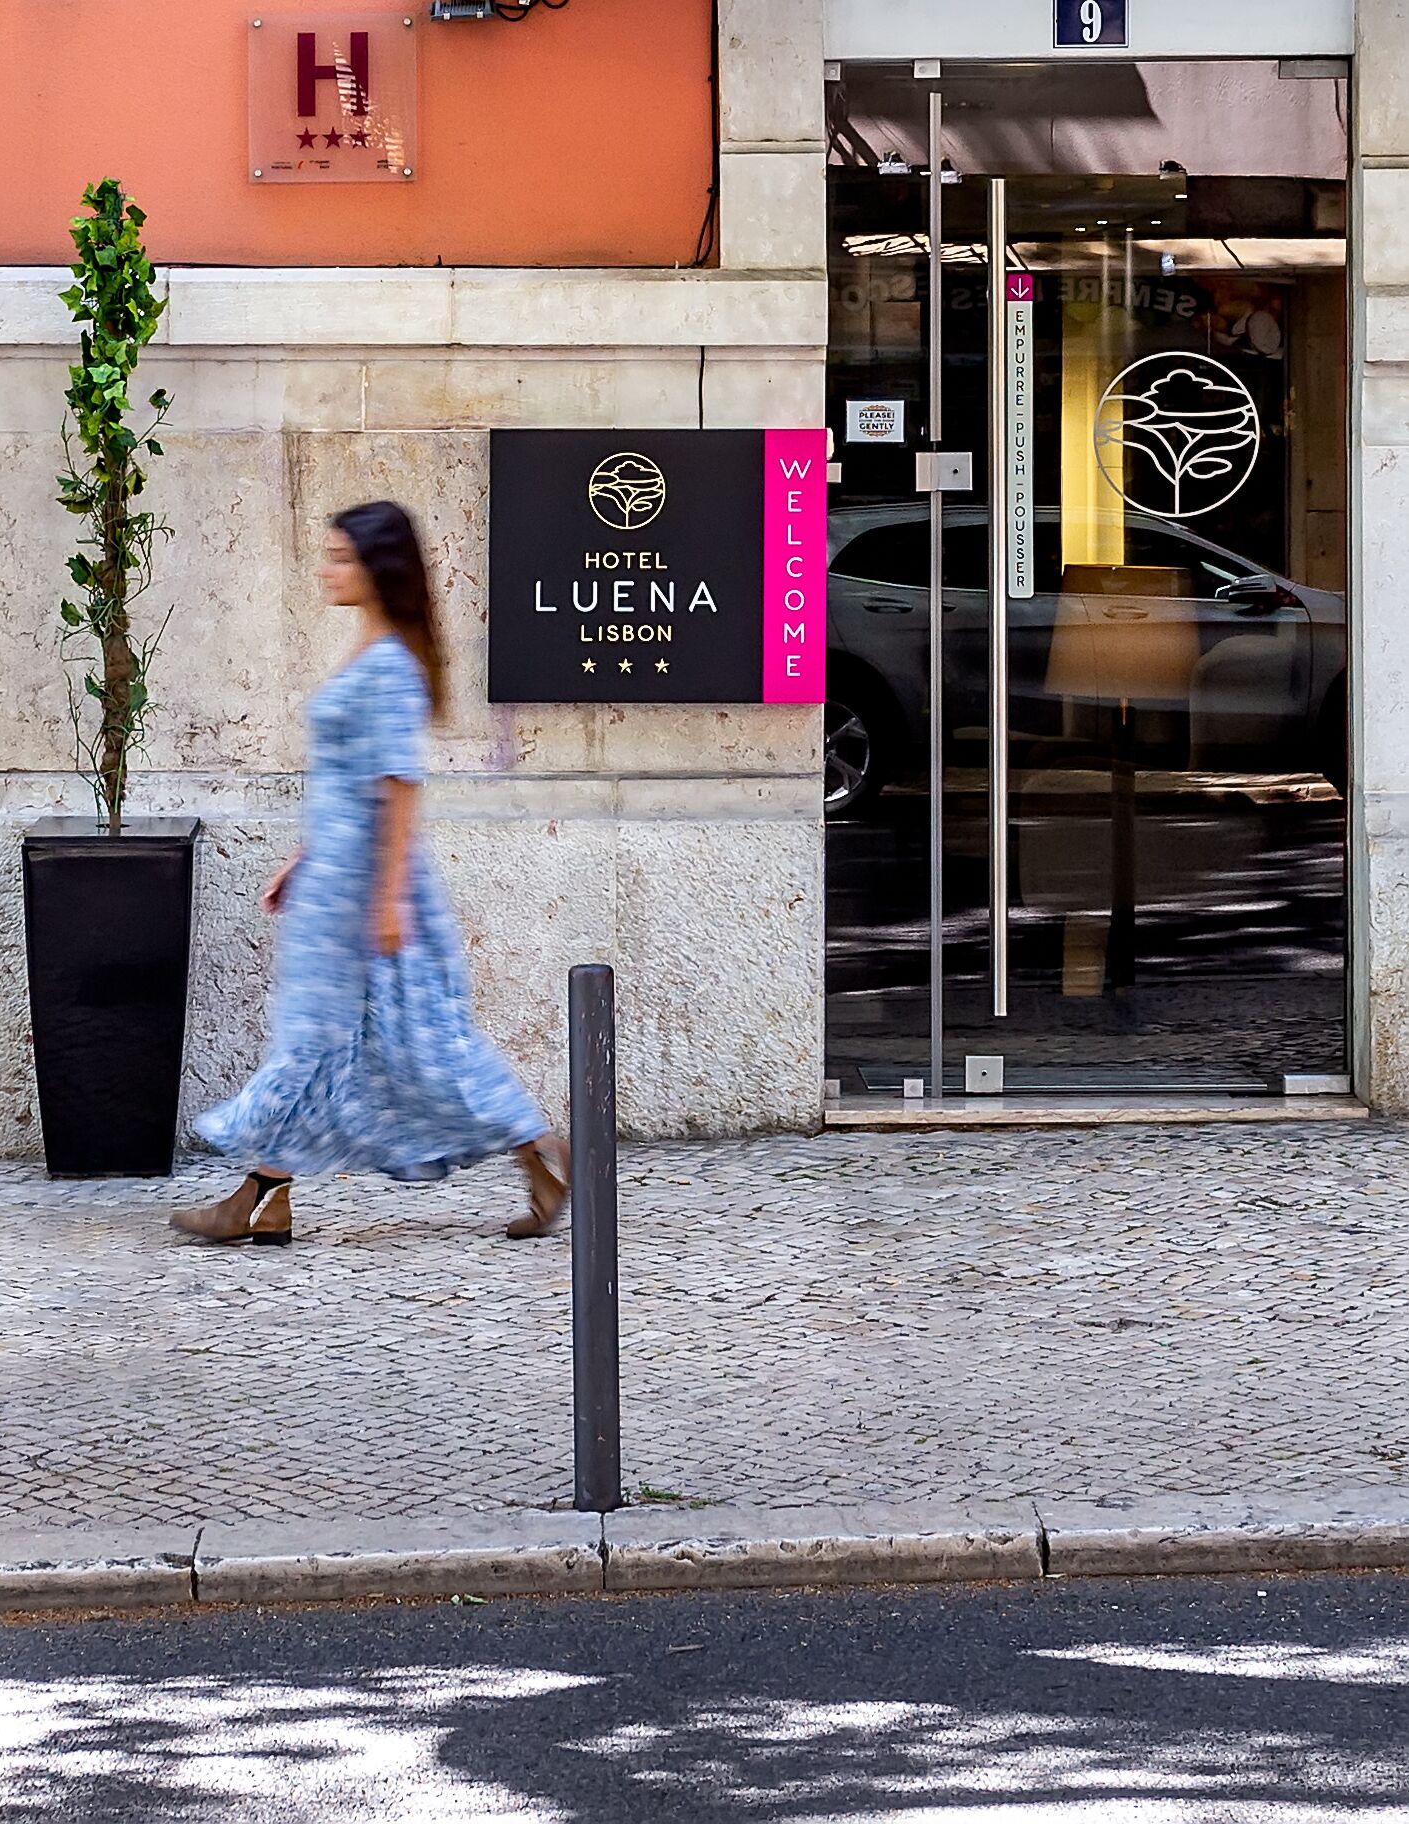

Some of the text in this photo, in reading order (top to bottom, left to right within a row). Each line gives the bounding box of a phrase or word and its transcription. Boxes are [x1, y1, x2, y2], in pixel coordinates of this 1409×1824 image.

[1080, 0, 1102, 43] 9
[297, 32, 369, 117] H
[859, 422, 894, 430] GENTLY
[585, 552, 668, 570] HOTEL
[779, 458, 812, 677] WELCOME
[535, 580, 718, 613] LUENA
[580, 624, 672, 642] LISBON
